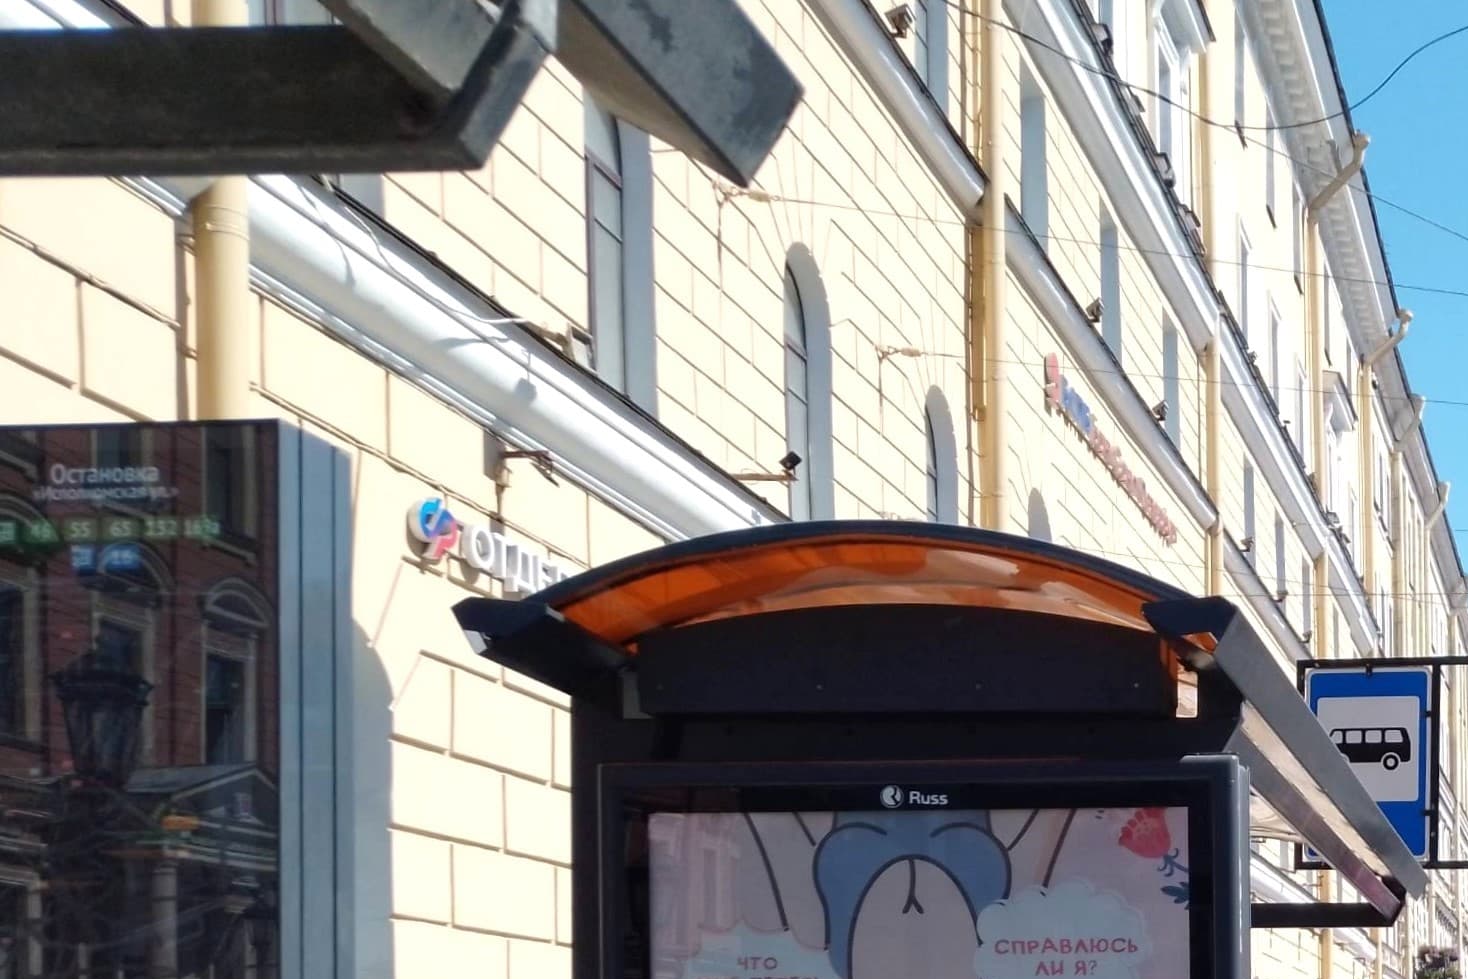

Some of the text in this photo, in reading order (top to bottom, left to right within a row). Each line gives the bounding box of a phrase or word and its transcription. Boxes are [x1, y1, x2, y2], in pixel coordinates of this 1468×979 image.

[50, 463, 160, 484] Остановка
[70, 520, 91, 537] 55
[110, 520, 133, 537] 65
[464, 524, 574, 594] ОТДЕ
[909, 790, 949, 805] Russ
[994, 937, 1138, 955] СПРАВЛЮСЬ
[737, 956, 778, 970] ЧТО
[1035, 959, 1098, 976] ЛИ Я?
